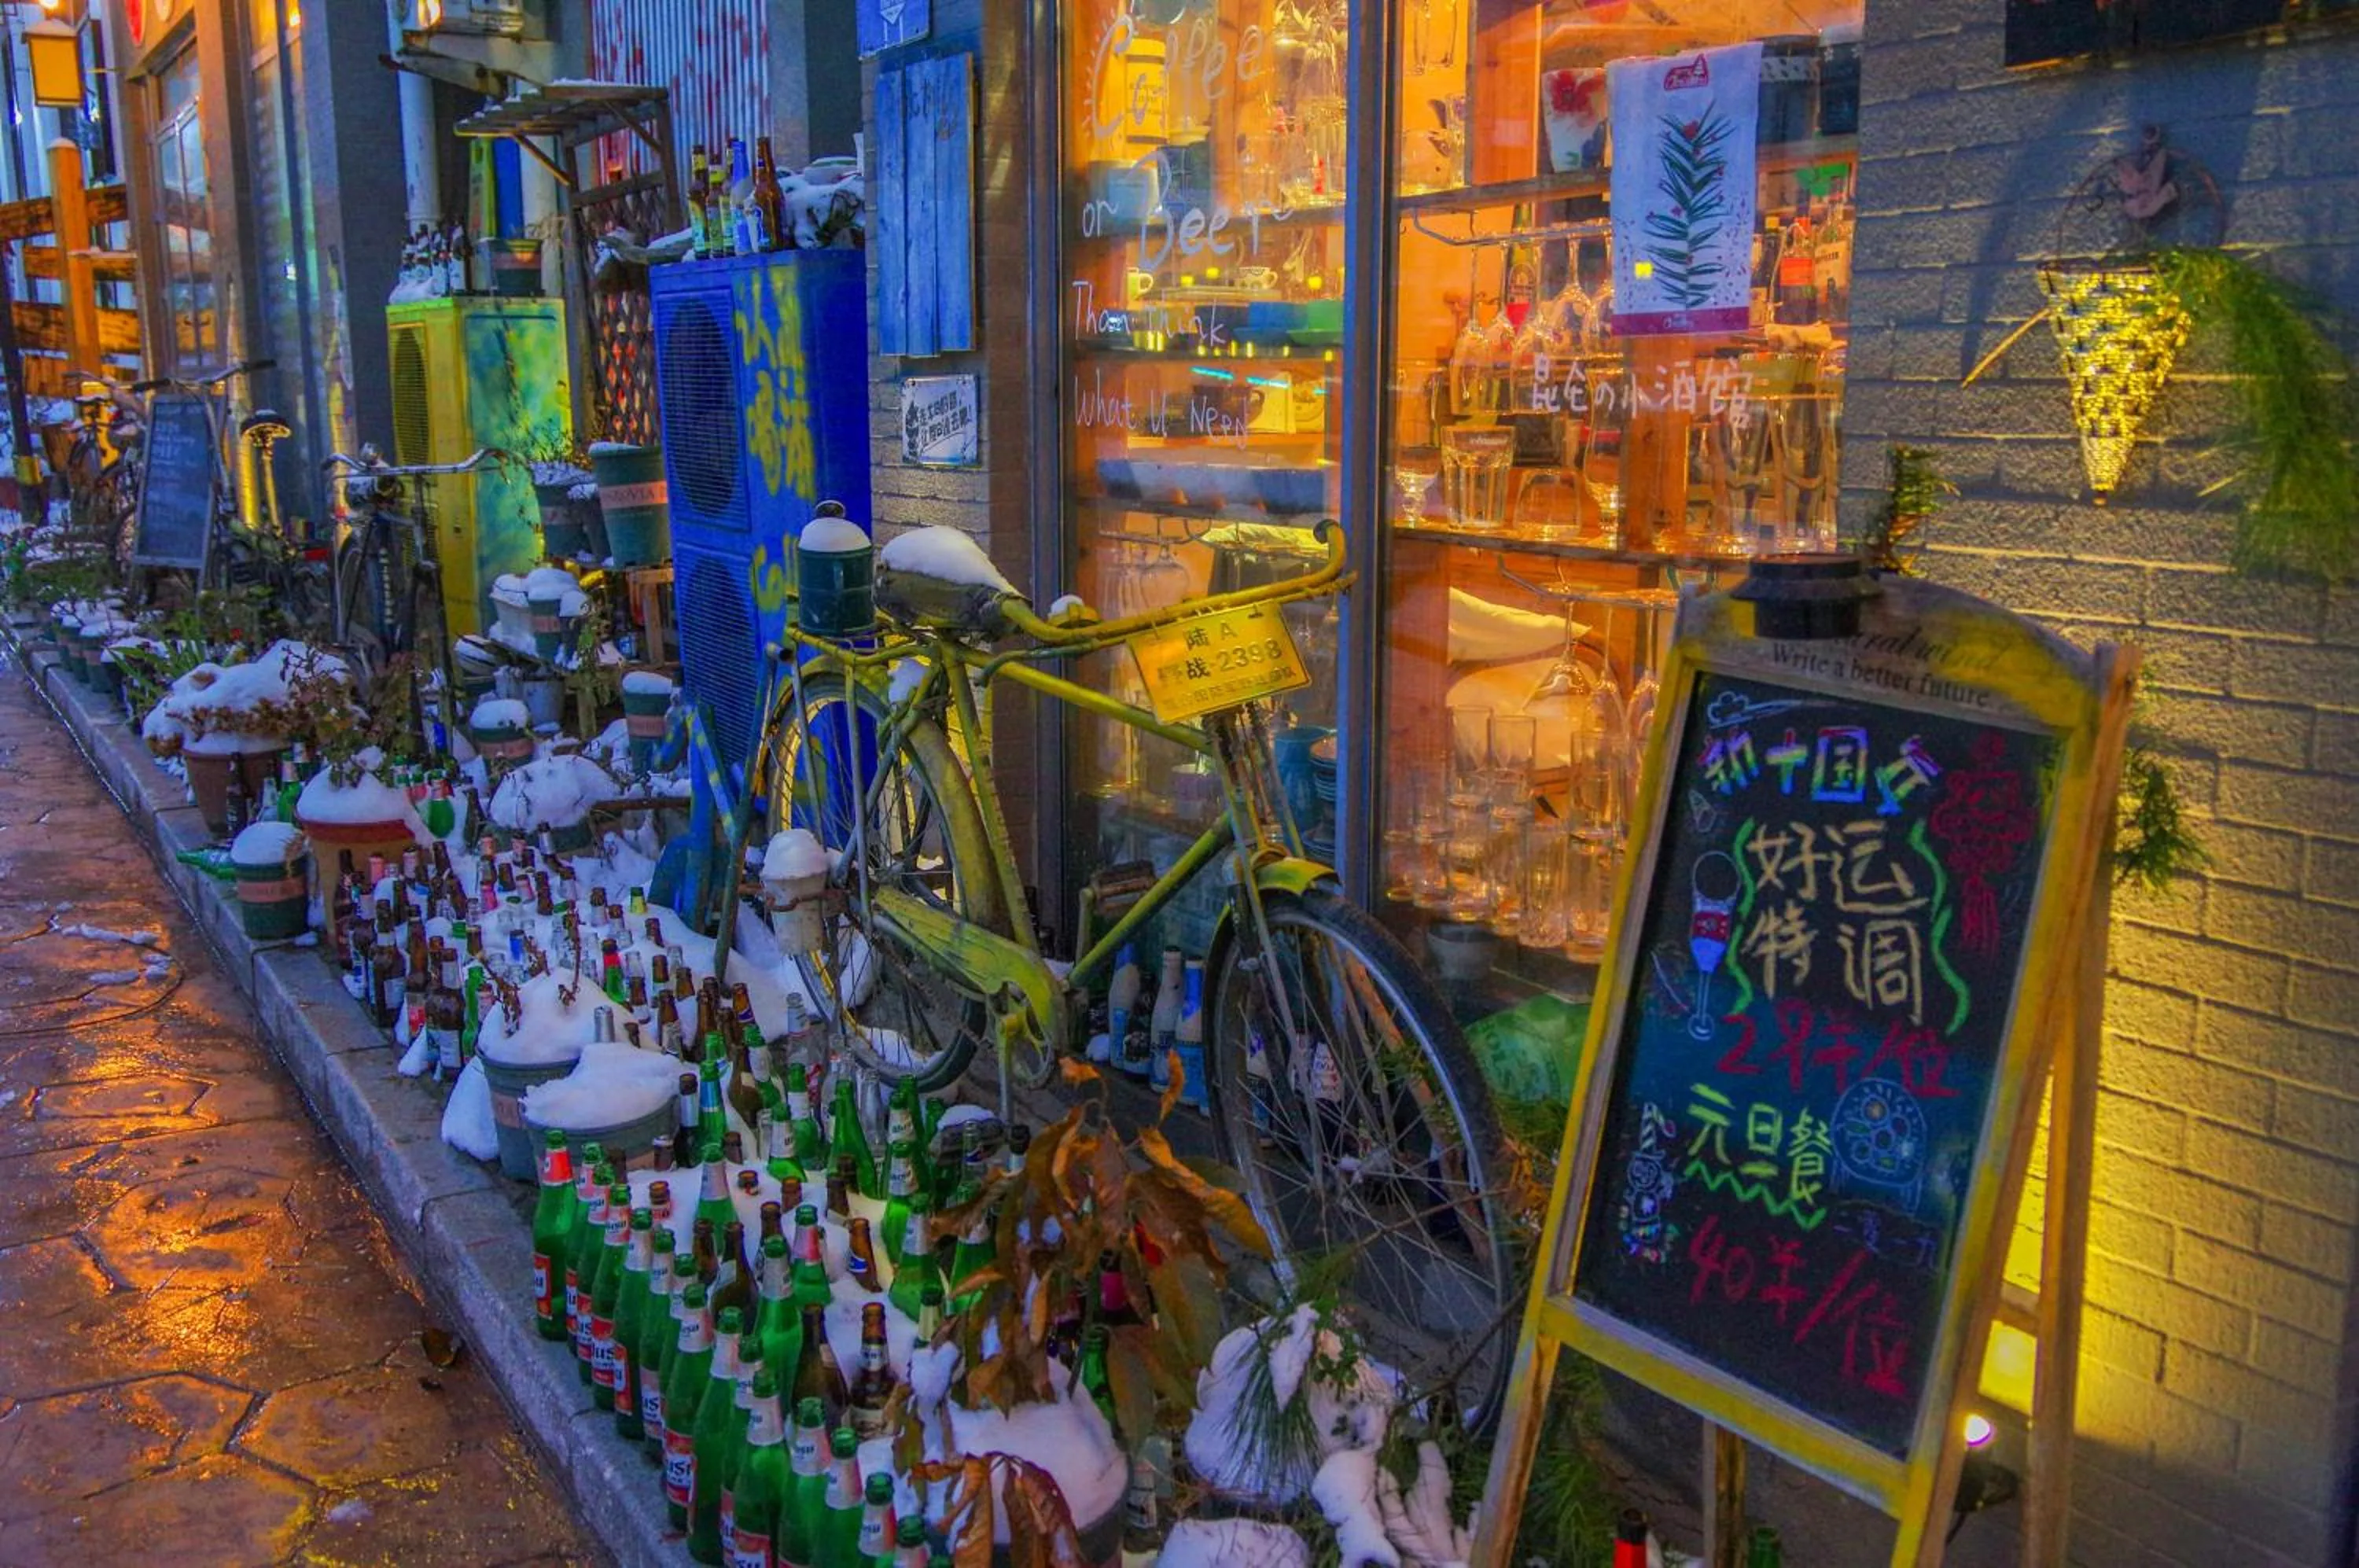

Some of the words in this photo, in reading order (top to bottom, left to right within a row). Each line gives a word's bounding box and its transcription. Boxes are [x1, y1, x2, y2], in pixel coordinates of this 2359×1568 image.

[1082, 198, 1120, 237] or
[1772, 642, 1832, 673] Write
[1833, 661, 1846, 679] a
[1849, 657, 1913, 693] better
[1746, 820, 1928, 915] 好运
[1746, 901, 1923, 1025] 特调
